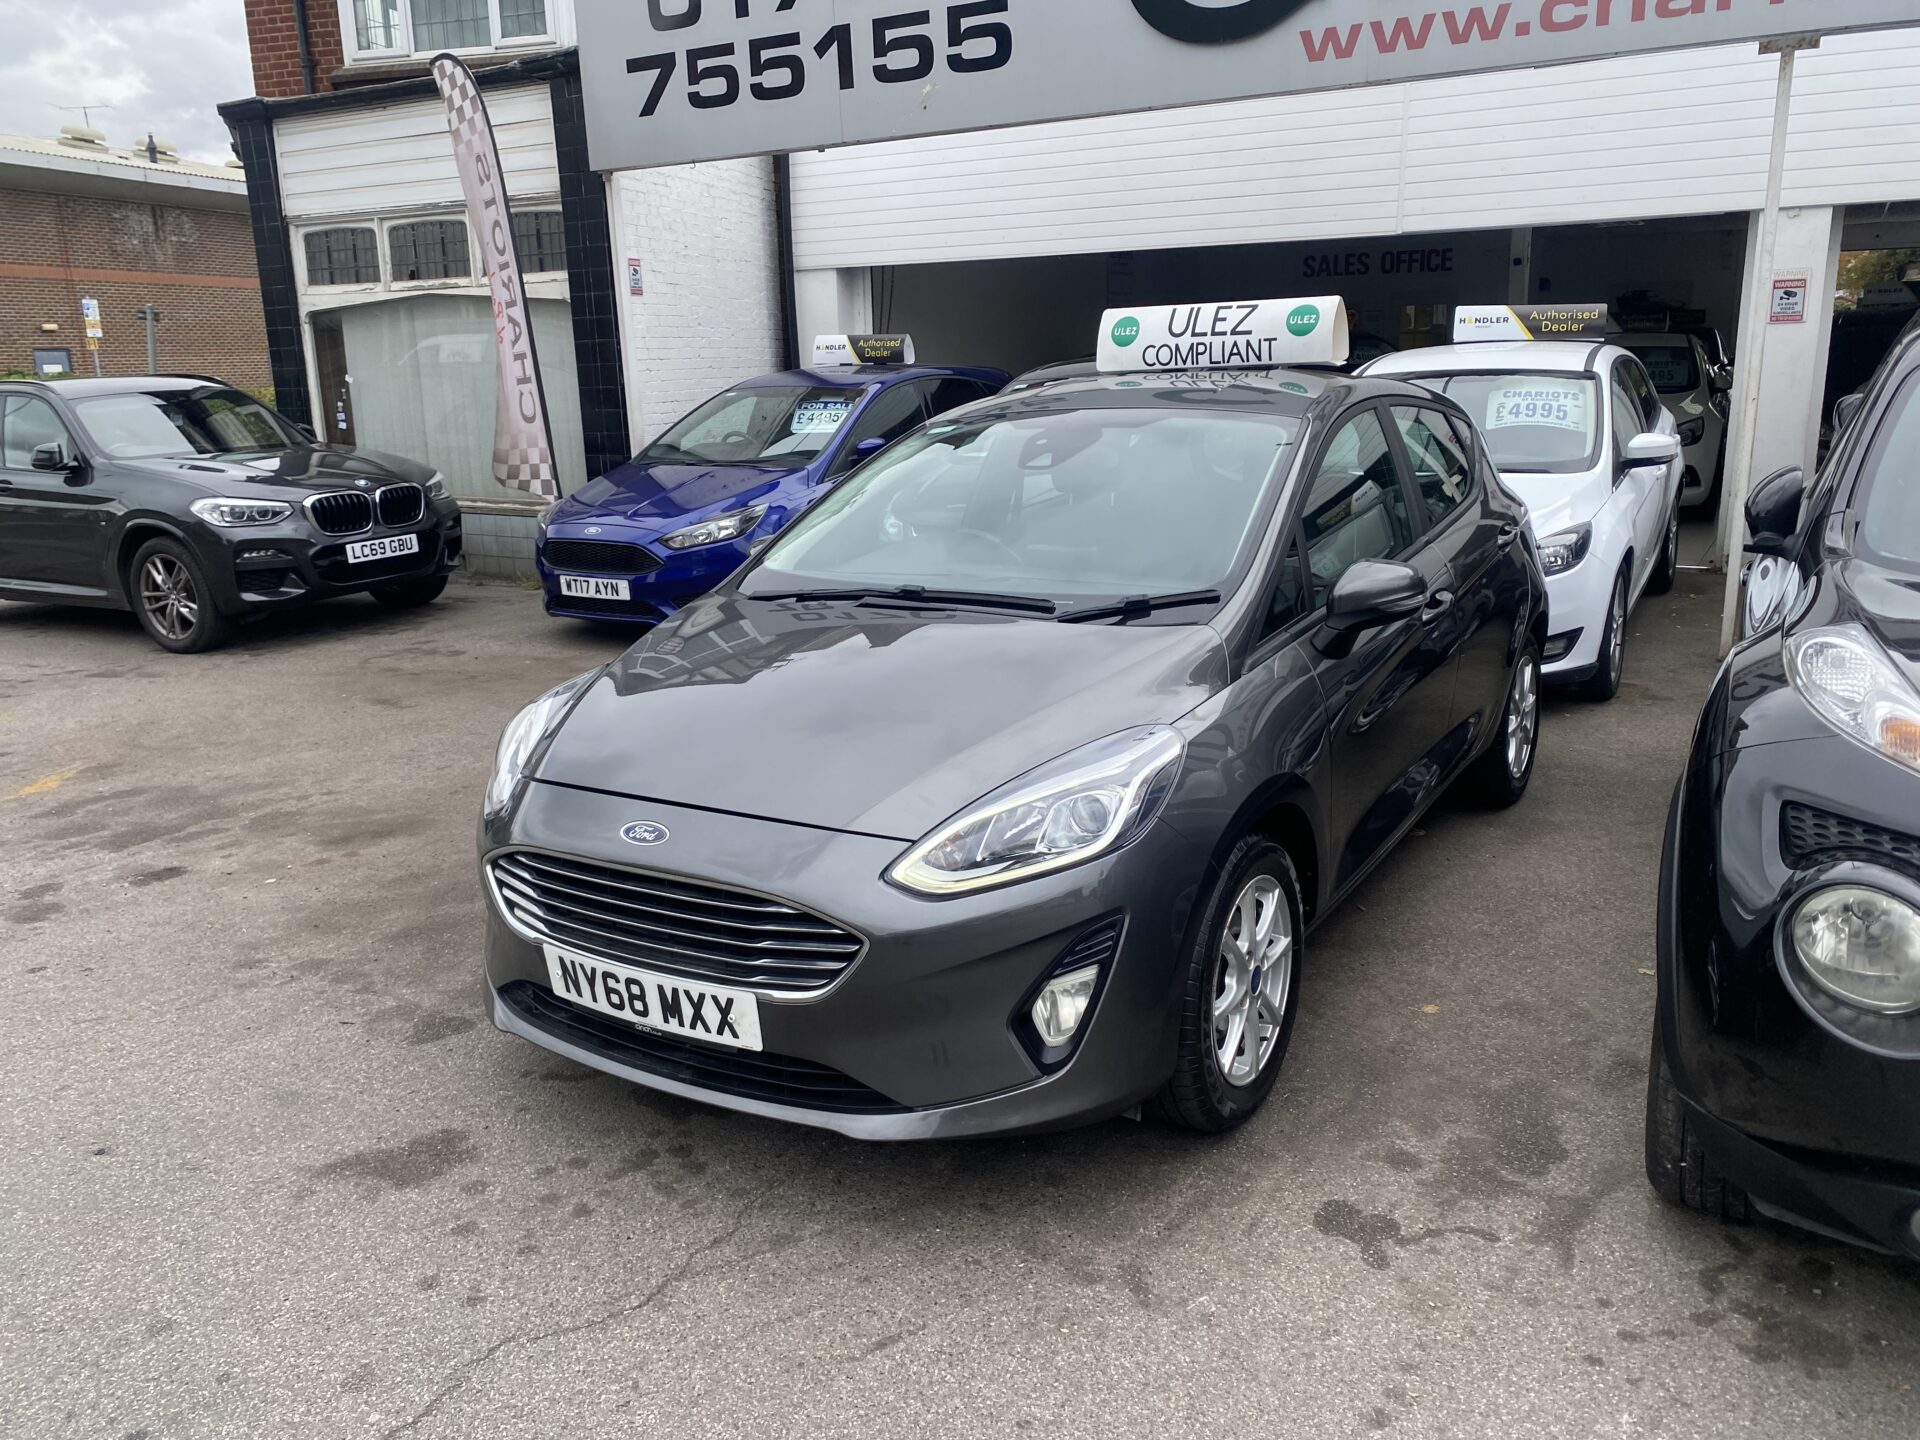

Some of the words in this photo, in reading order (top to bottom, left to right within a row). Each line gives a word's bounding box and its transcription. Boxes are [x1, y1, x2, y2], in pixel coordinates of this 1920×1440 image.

[626, 0, 1012, 118] 755155
[1302, 252, 1370, 278] SALES
[1380, 248, 1453, 274] OFFICE
[1168, 304, 1259, 338] ULEZ
[1289, 314, 1317, 325] ULEZ
[1530, 309, 1599, 320] Authorised
[1114, 326, 1137, 336] ULEZ
[1541, 321, 1584, 332] Dealer
[858, 338, 901, 347] Authorised
[864, 348, 891, 357] Dealer
[1142, 337, 1277, 367] COMPLIANT
[1503, 390, 1580, 401] CHARIOTS
[351, 541, 387, 560] LC69
[389, 537, 413, 553] GBU
[564, 577, 590, 594] WT17
[595, 581, 619, 597] AYN
[558, 955, 649, 1018] NY68
[657, 984, 740, 1039] MXX
